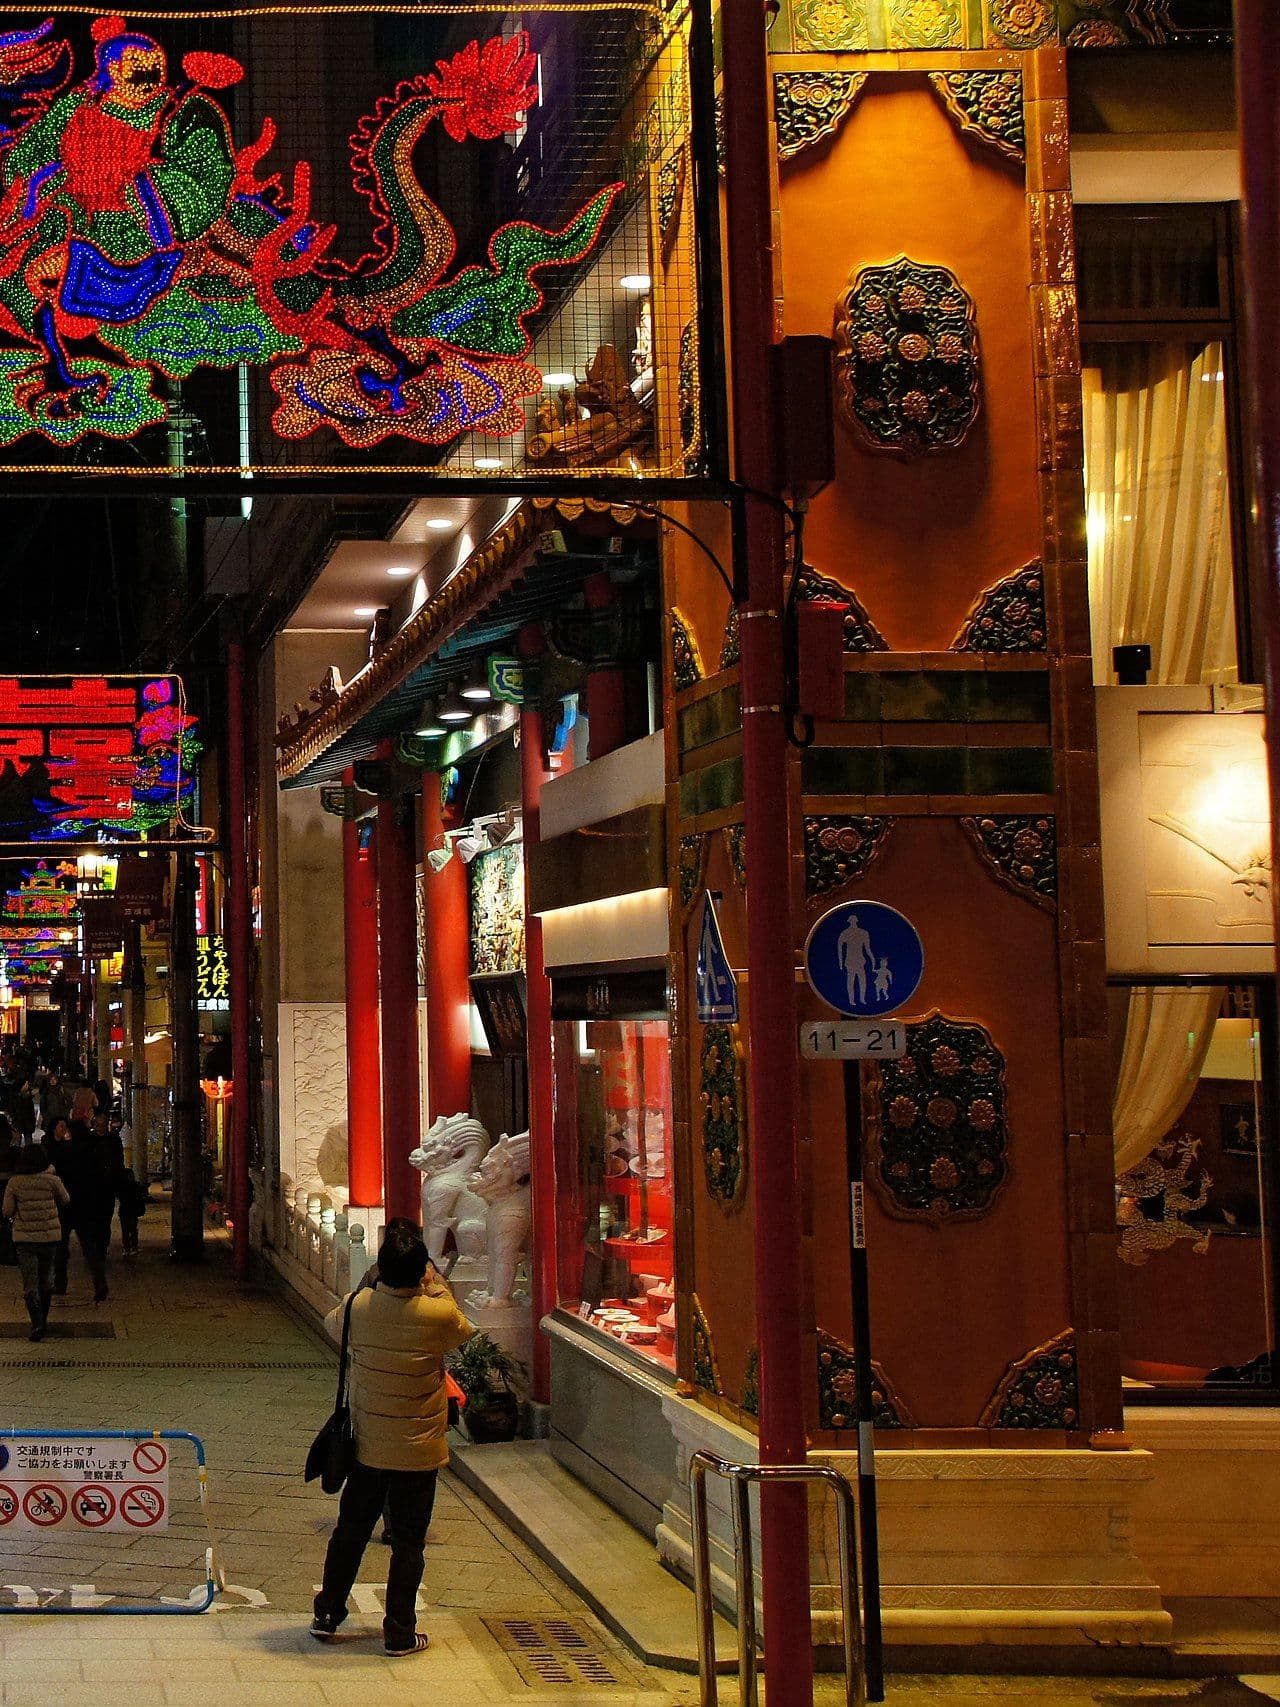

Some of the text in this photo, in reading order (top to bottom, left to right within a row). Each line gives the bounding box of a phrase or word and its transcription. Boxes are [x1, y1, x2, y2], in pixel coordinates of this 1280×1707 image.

[196, 936, 211, 998] 皿うどん
[212, 935, 230, 998] ちゃんぽん
[808, 1029, 897, 1052] 11-21
[16, 1445, 96, 1456] 交通規制中です
[17, 1459, 130, 1469] ご協力をお願いします
[83, 1470, 124, 1480] 警察署長
